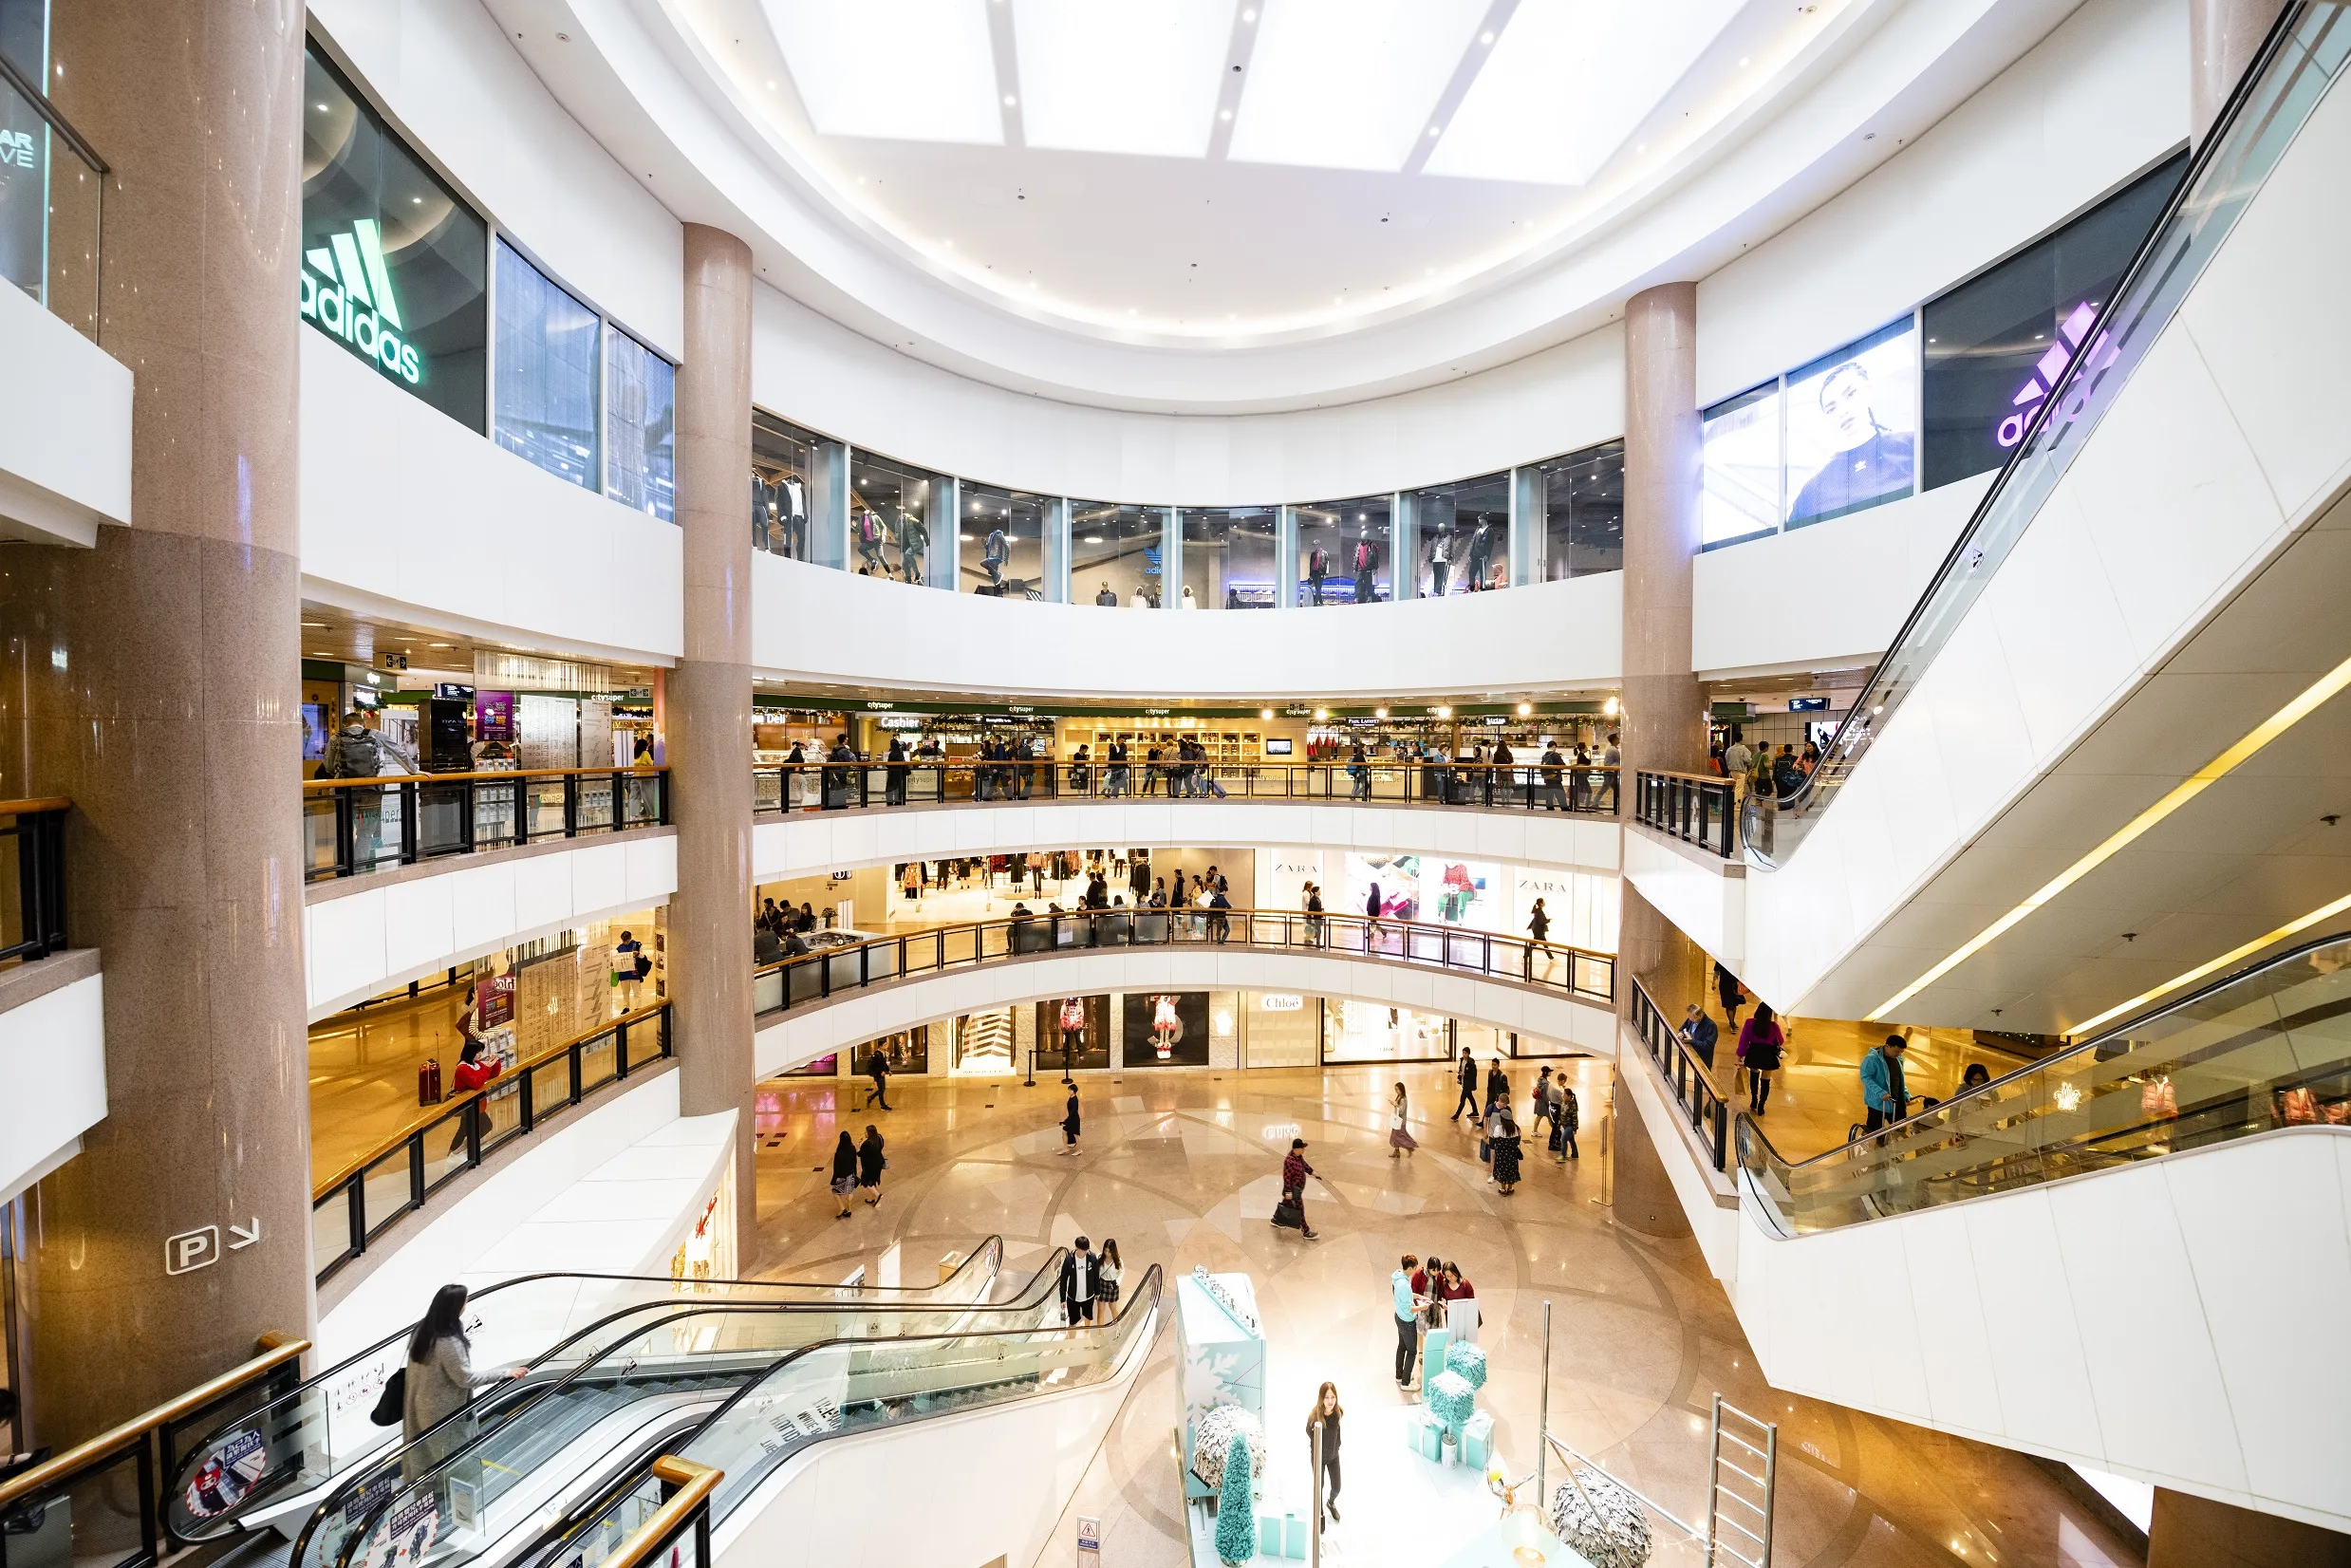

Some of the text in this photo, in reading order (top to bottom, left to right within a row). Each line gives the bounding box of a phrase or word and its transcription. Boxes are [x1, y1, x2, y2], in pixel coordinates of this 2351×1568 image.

[881, 717, 920, 727] Cashier
[1275, 864, 1317, 873] ZARA
[1519, 879, 1567, 893] ZARA
[179, 1236, 208, 1268] P
